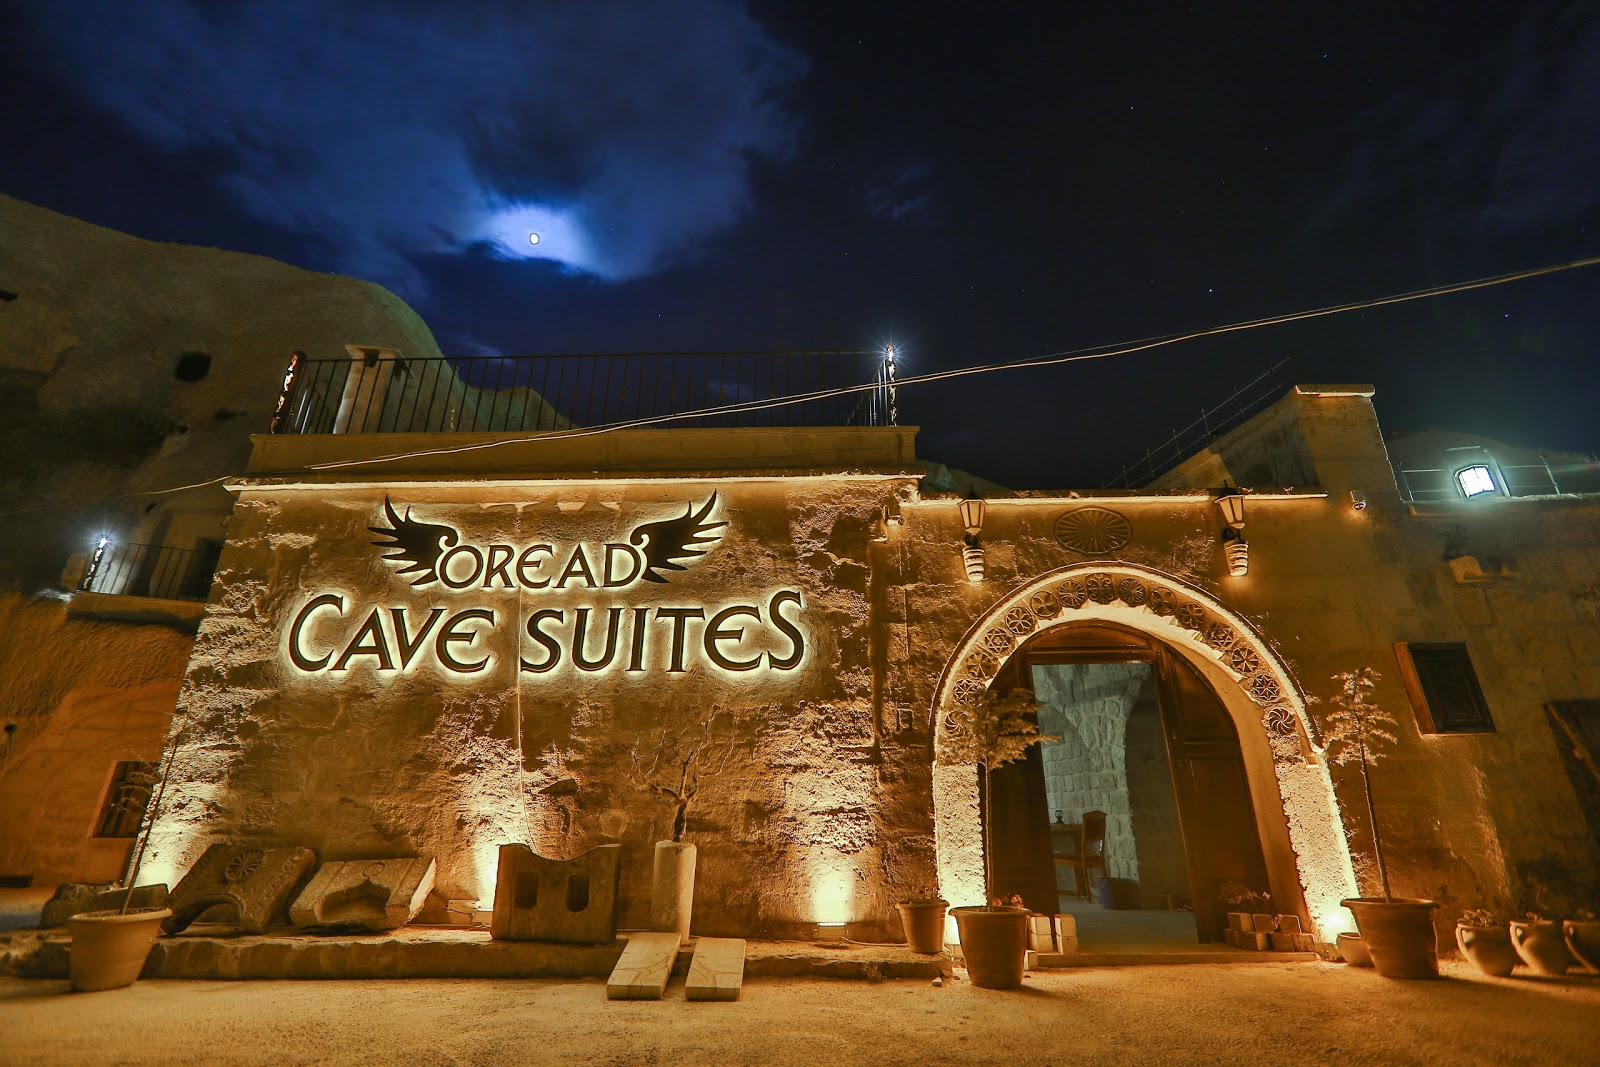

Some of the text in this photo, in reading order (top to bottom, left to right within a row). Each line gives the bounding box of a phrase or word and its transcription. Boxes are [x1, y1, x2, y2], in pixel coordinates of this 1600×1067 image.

[438, 543, 642, 589] OREAD
[288, 591, 803, 673] CAVE SUITES
